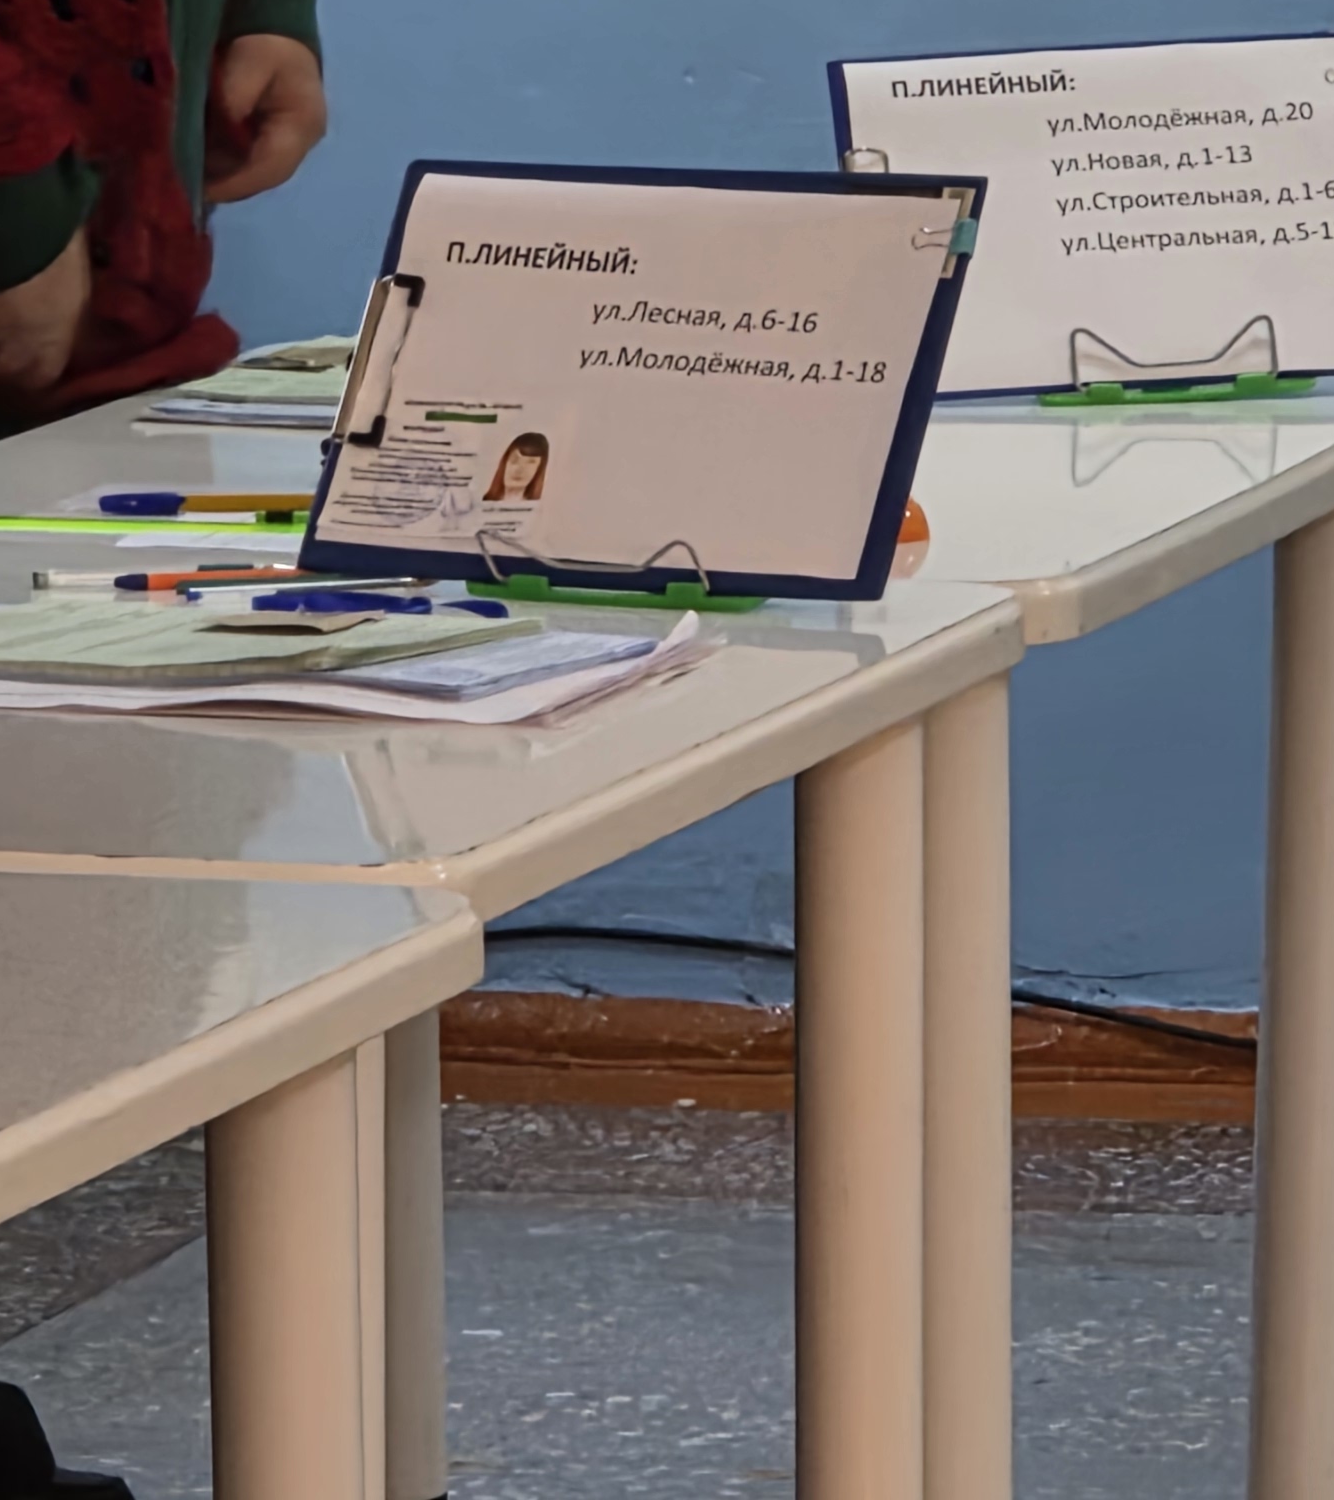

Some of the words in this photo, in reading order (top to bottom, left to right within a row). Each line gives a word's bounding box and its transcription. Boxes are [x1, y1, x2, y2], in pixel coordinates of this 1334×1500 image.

[891, 68, 1076, 99] П.ЛИНЕЙНЫЙ:
[1046, 108, 1254, 138] ул.Молодёжная,
[1261, 101, 1314, 127] д.20
[1050, 152, 1170, 177] ул.Новая,
[1176, 144, 1253, 171] д.1-13
[1055, 188, 1270, 218] ул.Строительная,
[445, 240, 639, 276] П.ЛИНЕЙНЫЙ:
[1060, 228, 1266, 257] ул.Центральная,
[592, 300, 727, 331] ул.Лесная,
[732, 308, 819, 335] д.6-16
[579, 345, 795, 382] ул.Молодёжная,
[800, 359, 887, 385] д.1-18
